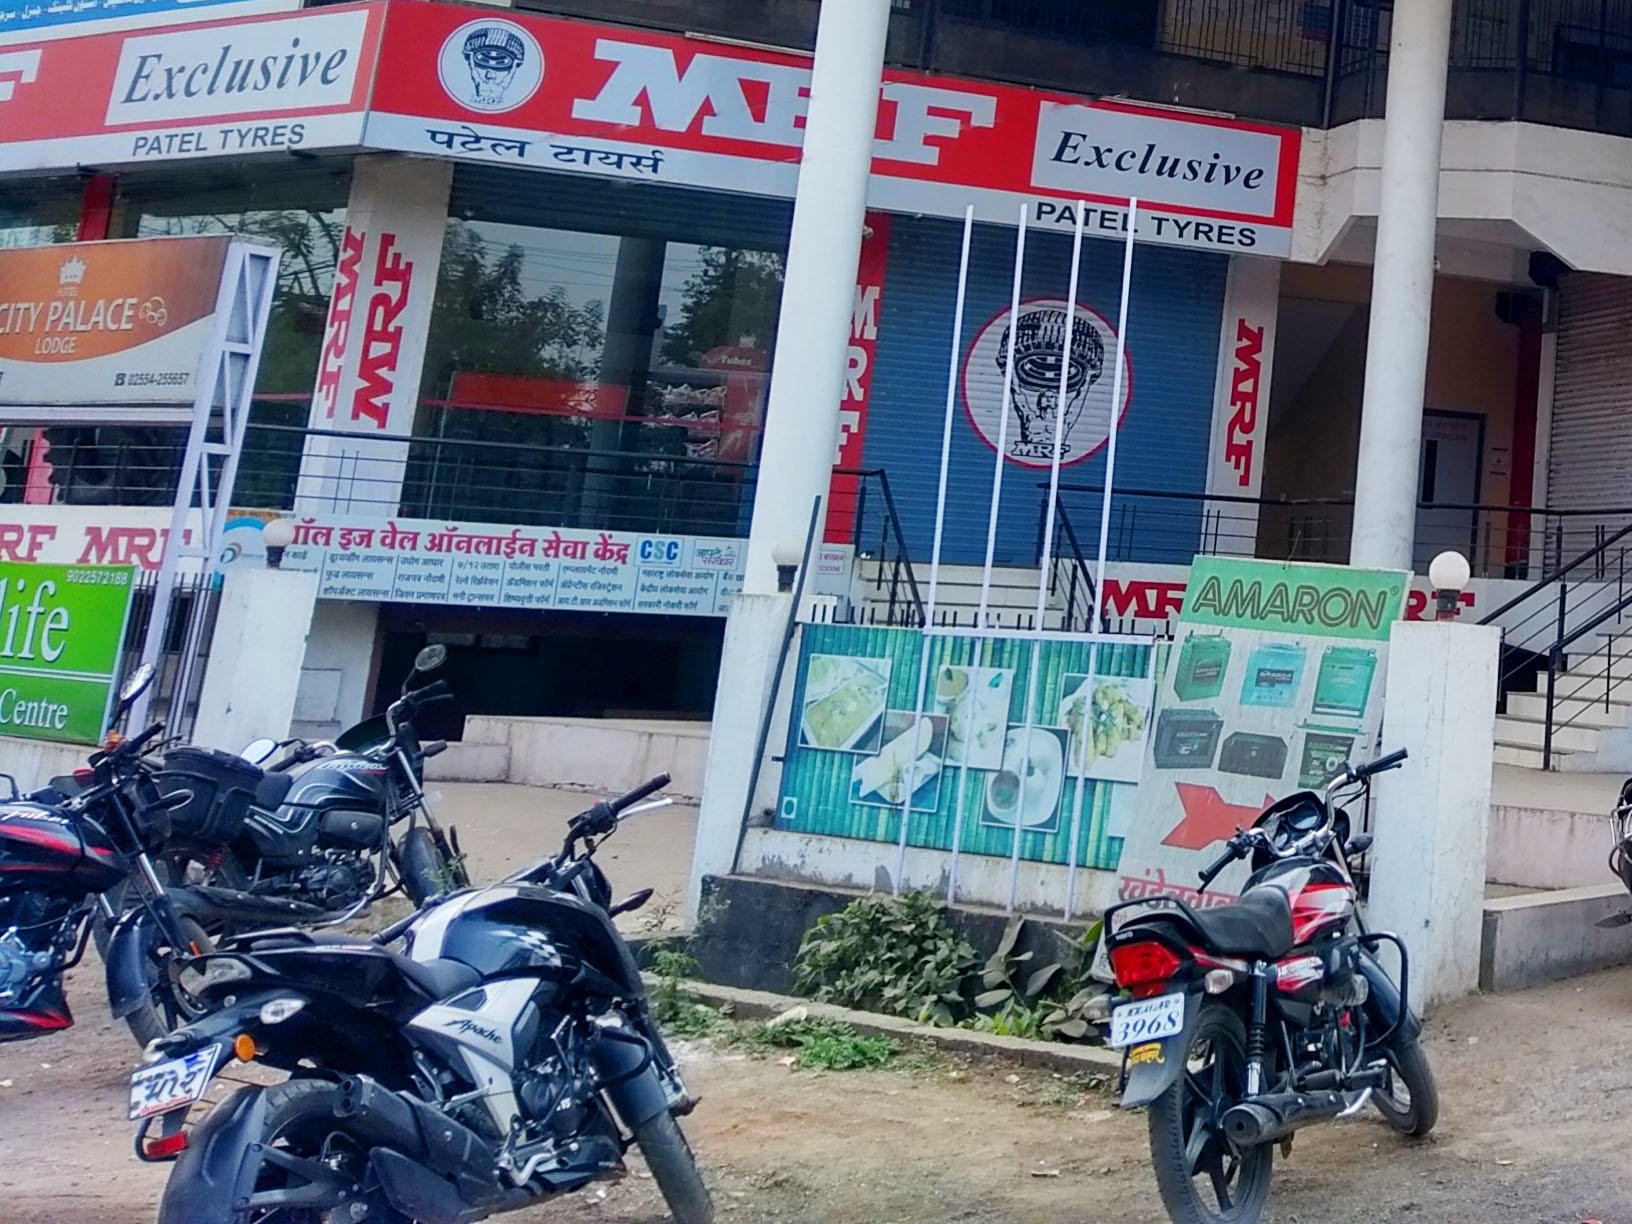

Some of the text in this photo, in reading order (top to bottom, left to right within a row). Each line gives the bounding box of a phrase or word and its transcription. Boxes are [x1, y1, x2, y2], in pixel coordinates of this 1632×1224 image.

[121, 37, 348, 105] Exclusive
[132, 124, 305, 157] PATEL TYRES
[426, 125, 665, 176] पटेल टायर्स
[1050, 129, 1266, 193] Exclusive
[1035, 201, 1257, 248] PATEL TYRES
[45, 297, 139, 334] PALACE
[318, 225, 367, 420] MRF
[351, 232, 414, 430] MRF
[34, 336, 78, 356] LODGE
[1223, 317, 1265, 488] MRF
[379, 520, 421, 552] वेल
[424, 526, 538, 560] ऑनलाईन
[542, 530, 590, 560] सेवा
[593, 532, 631, 565] केंद्र
[640, 539, 679, 561] CSC
[1193, 575, 1390, 631] AMARON
[0, 687, 69, 730] Centre
[442, 1019, 503, 1044] Apache
[1114, 1010, 1180, 1044] 3968
